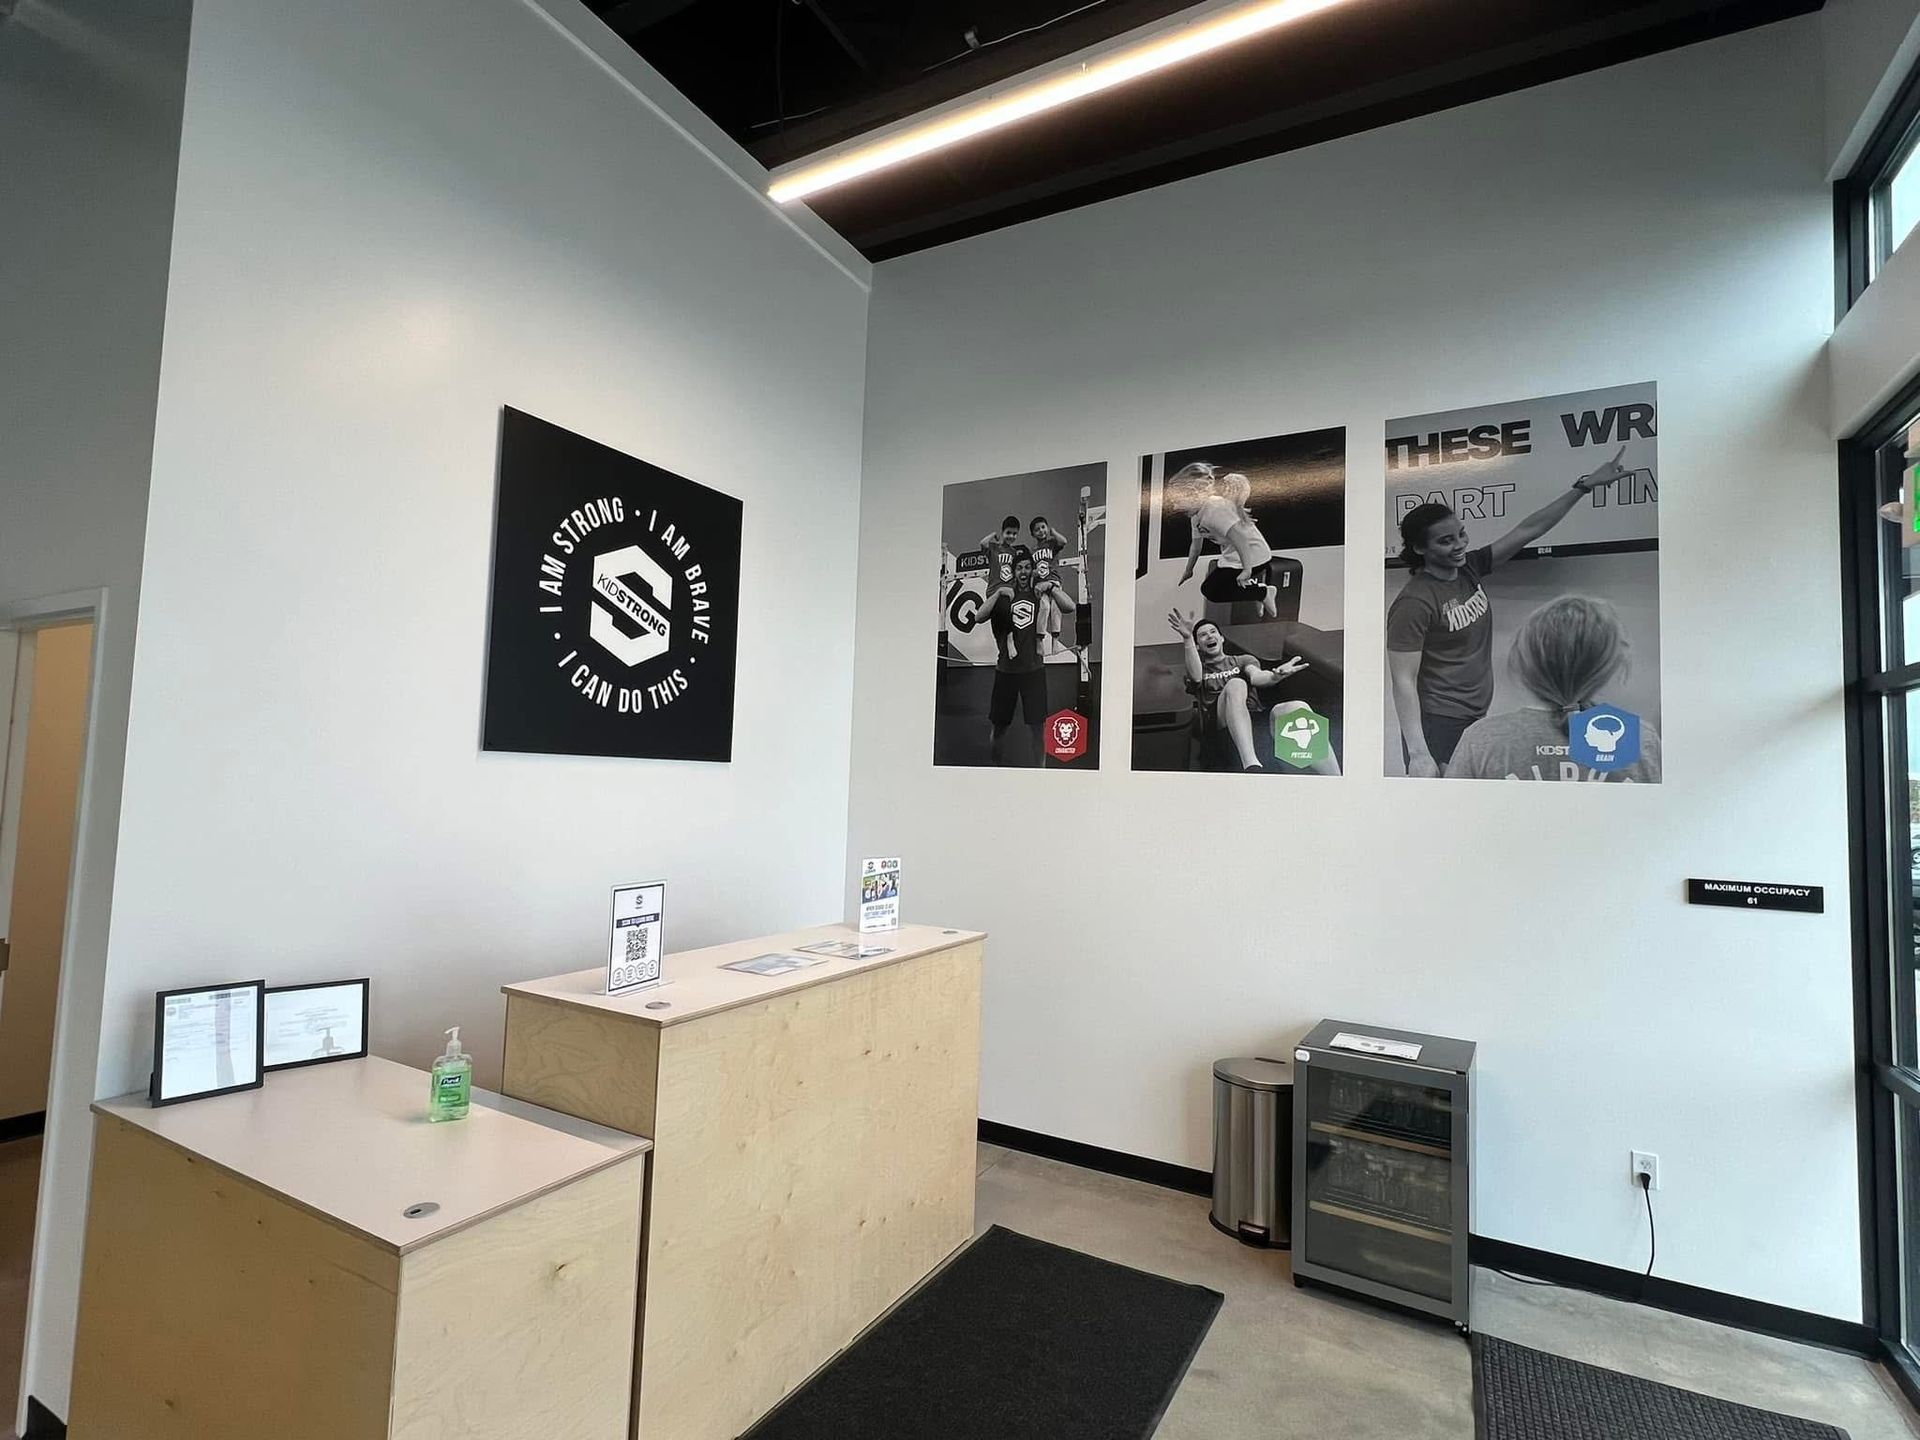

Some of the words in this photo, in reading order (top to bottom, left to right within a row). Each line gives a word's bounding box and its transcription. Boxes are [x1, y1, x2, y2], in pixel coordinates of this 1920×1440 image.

[1385, 419, 1531, 470] THESE
[1560, 400, 1657, 448] WR
[552, 496, 625, 555] STRONG
[539, 554, 567, 597] AM
[998, 553, 1013, 565] TITA
[1032, 548, 1053, 562] TITAN
[649, 509, 657, 532] I
[661, 523, 691, 561] AM
[685, 563, 711, 645] BRAVE
[597, 573, 667, 637] KIDSTRONG
[558, 650, 578, 668] I
[571, 664, 613, 708] CAN
[618, 687, 643, 714] DO
[648, 668, 689, 710] THIS
[1596, 754, 1615, 762] BRAIN
[1704, 883, 1751, 893] MAXIMUM
[1754, 886, 1811, 897] OCCUPACY
[1747, 897, 1758, 905] 61
